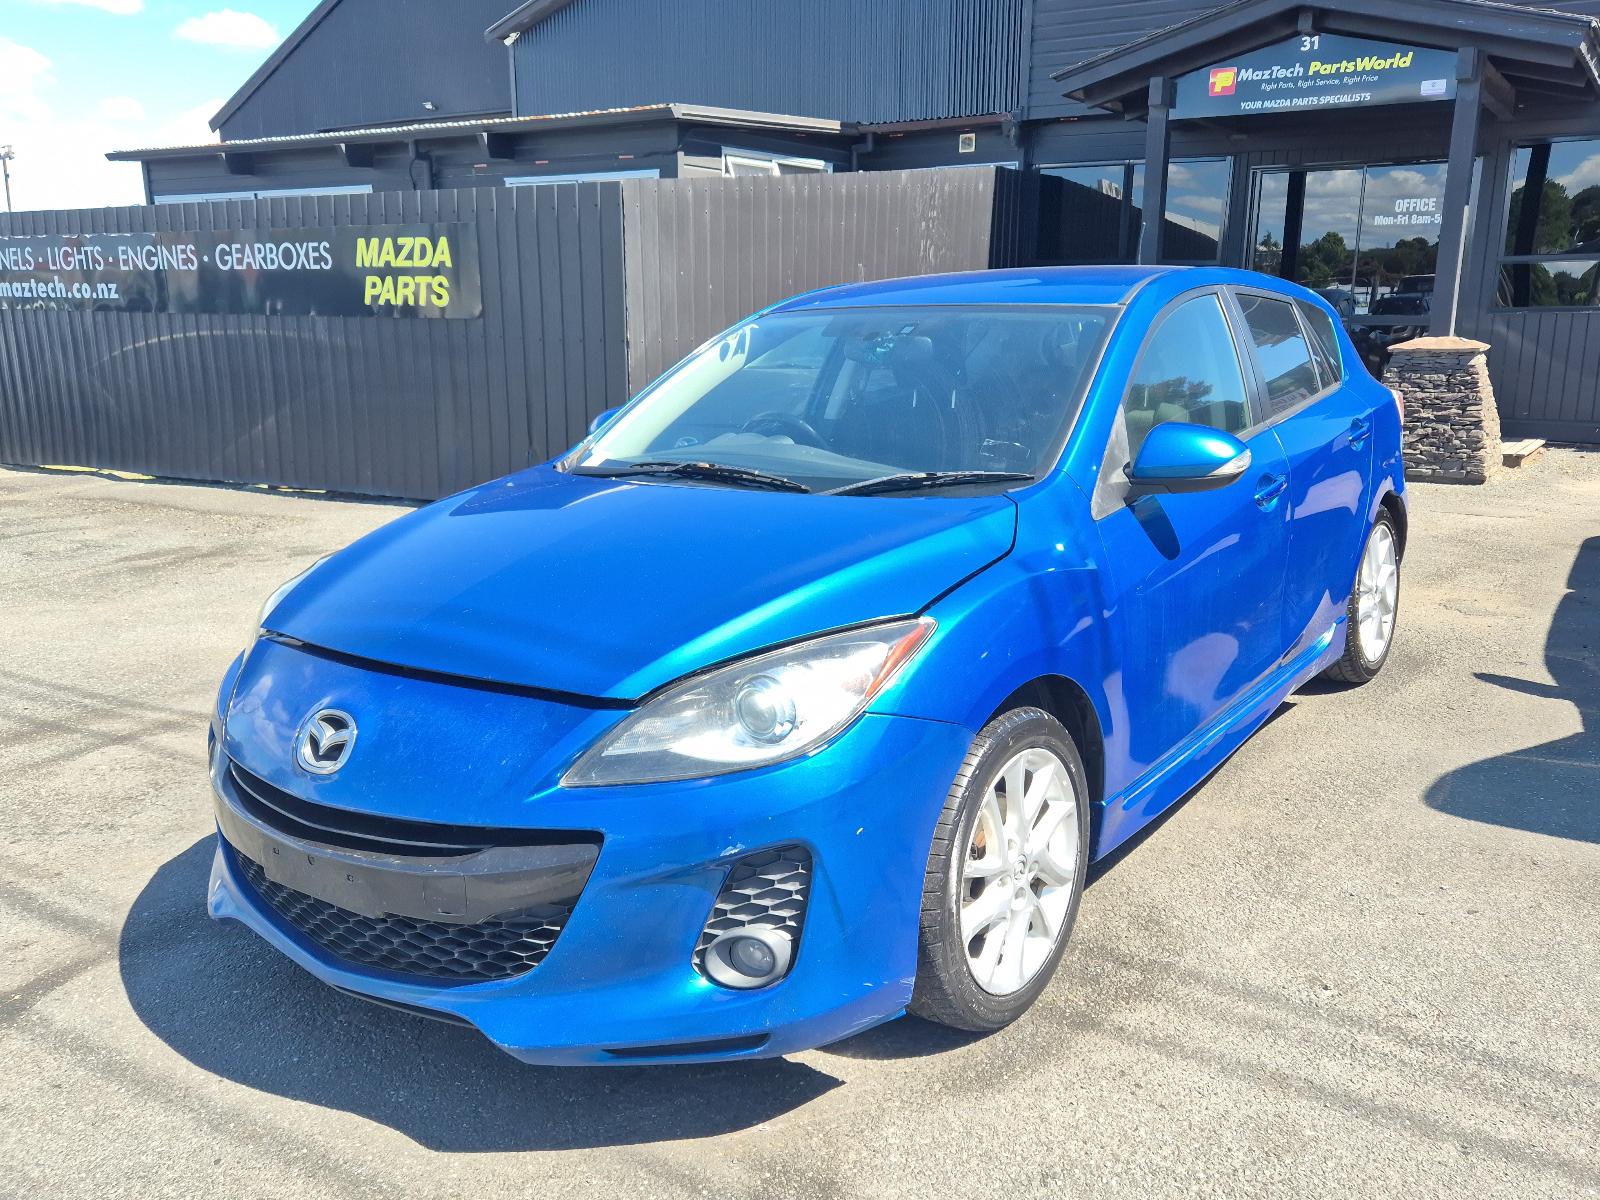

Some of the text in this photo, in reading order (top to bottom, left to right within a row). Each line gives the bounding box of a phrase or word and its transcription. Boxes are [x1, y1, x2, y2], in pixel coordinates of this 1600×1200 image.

[1300, 35, 1320, 51] 31
[1237, 52, 1414, 82] MazTech PartsWorld
[1260, 74, 1379, 91] Right Parts, Right Service, Right Price
[1240, 92, 1371, 110] YOUR MAZDA PARTS SPECIALISTS
[1395, 198, 1436, 212] OFFICE
[1374, 214, 1409, 225] Mon-Fri
[47, 246, 104, 271] LIGHTS
[118, 244, 198, 271] ENGINES
[215, 241, 332, 271] GEARBOXES
[355, 236, 452, 268] MAZDA
[0, 276, 119, 299] maztech.co.nz
[364, 275, 450, 308] PARTS
